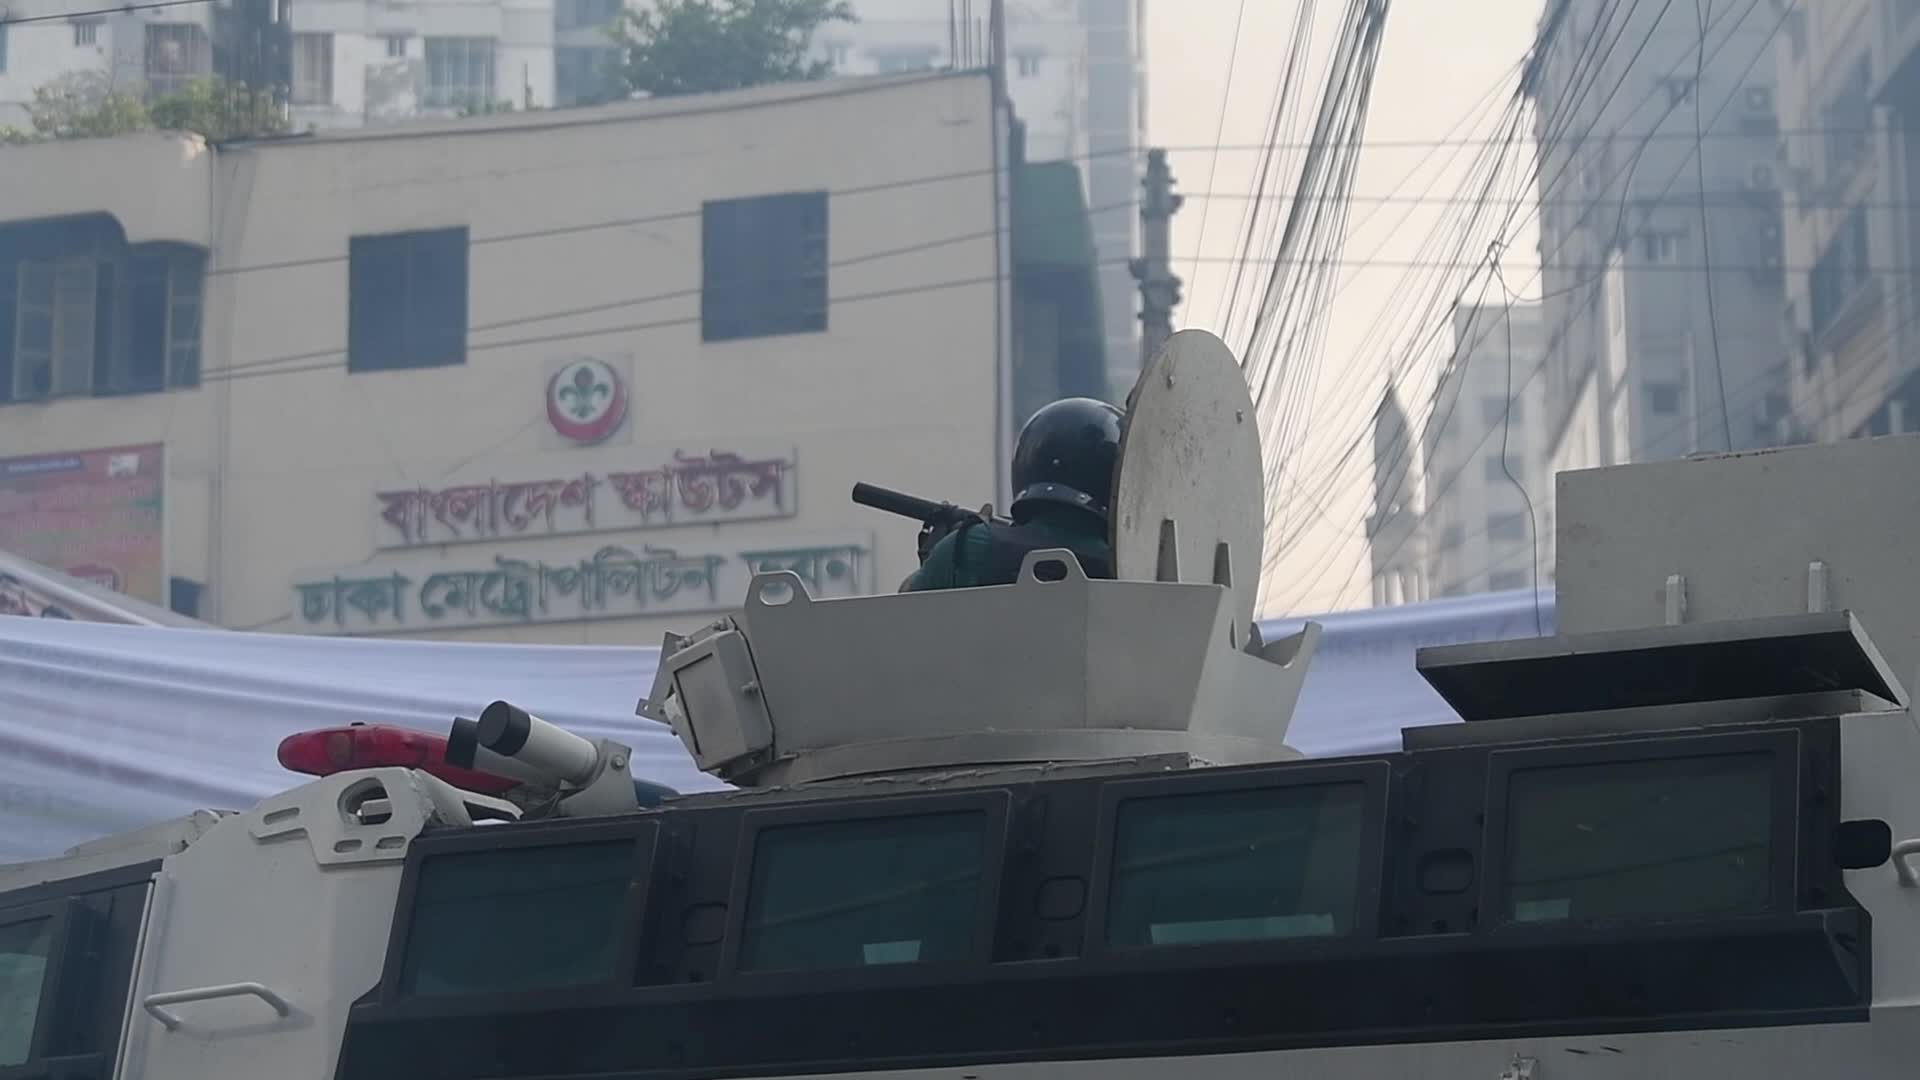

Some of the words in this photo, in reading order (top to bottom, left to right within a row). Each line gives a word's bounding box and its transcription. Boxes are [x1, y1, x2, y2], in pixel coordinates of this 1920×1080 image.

[376, 473, 601, 543] বাংলাদেশ
[608, 448, 790, 523] স্কাউটস
[293, 570, 412, 624] ঢাকা
[420, 545, 725, 619] মেট্রোপলিটন
